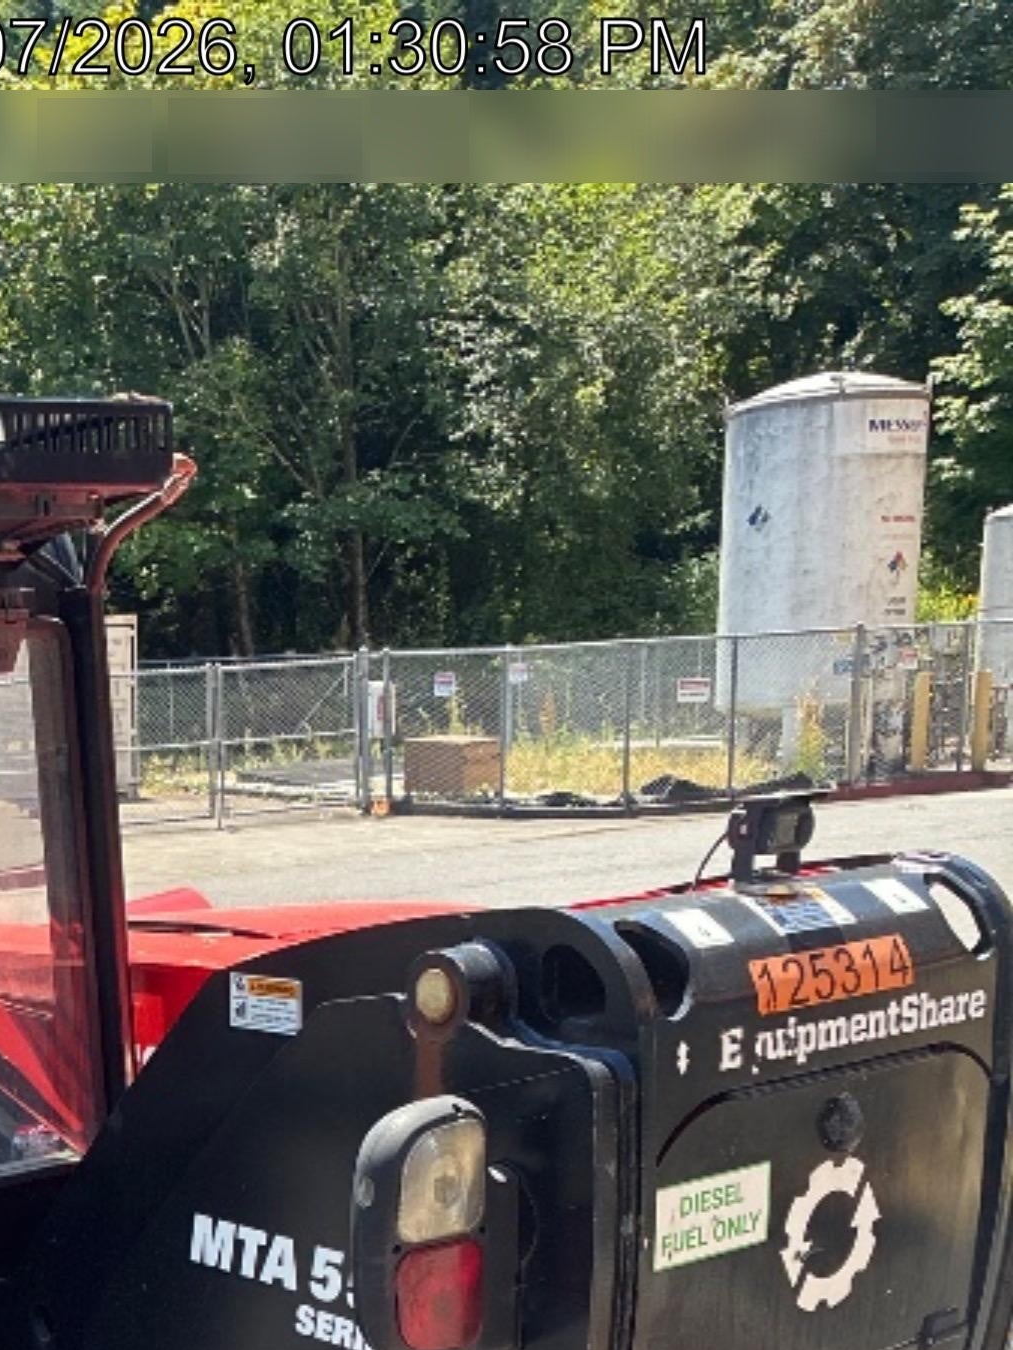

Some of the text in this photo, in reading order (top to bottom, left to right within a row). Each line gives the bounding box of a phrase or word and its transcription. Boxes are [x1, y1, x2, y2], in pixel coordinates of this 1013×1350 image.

[757, 939, 910, 1009] 125314
[679, 1182, 744, 1219] DIESEL
[189, 1211, 355, 1309] MTA 5
[661, 1208, 762, 1257] FUEL ONLY
